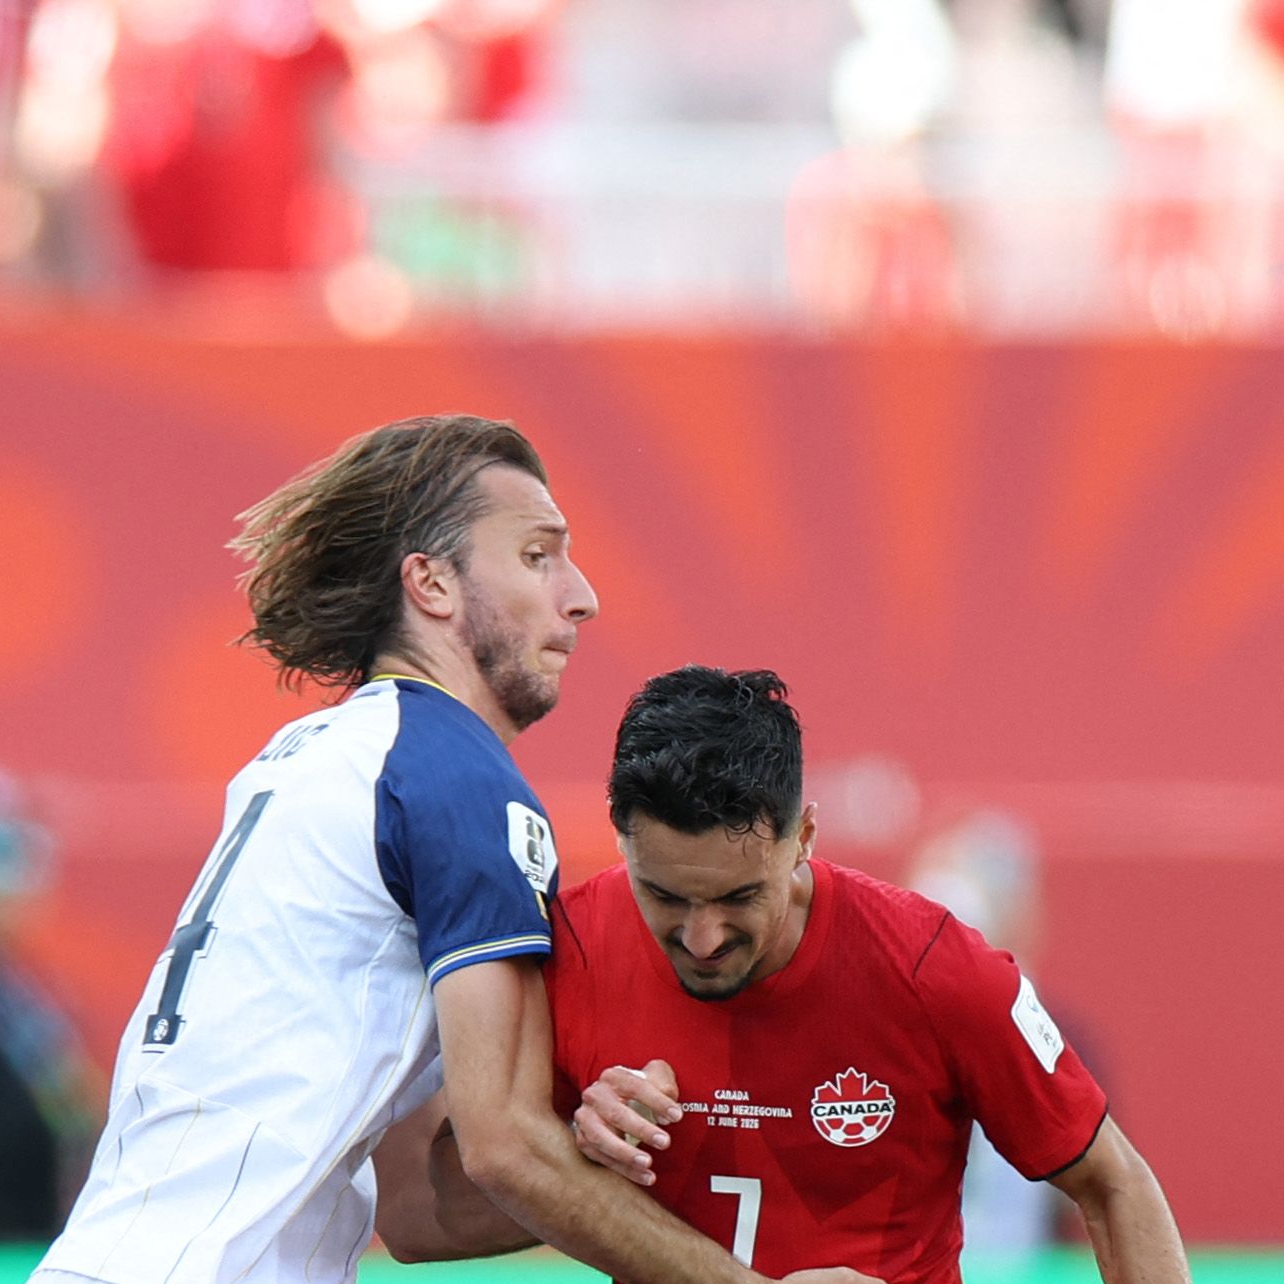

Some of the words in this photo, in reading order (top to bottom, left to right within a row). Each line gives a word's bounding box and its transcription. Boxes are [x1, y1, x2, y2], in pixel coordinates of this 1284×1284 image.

[714, 1089, 749, 1101] CANADA
[680, 1102, 709, 1113] OSNIA
[712, 1103, 730, 1114] AND
[732, 1104, 793, 1118] HERZEGOVINA
[813, 1102, 893, 1117] CANADA
[707, 1116, 715, 1126] 12
[718, 1117, 738, 1128] JUNE
[710, 1175, 762, 1269] 7
